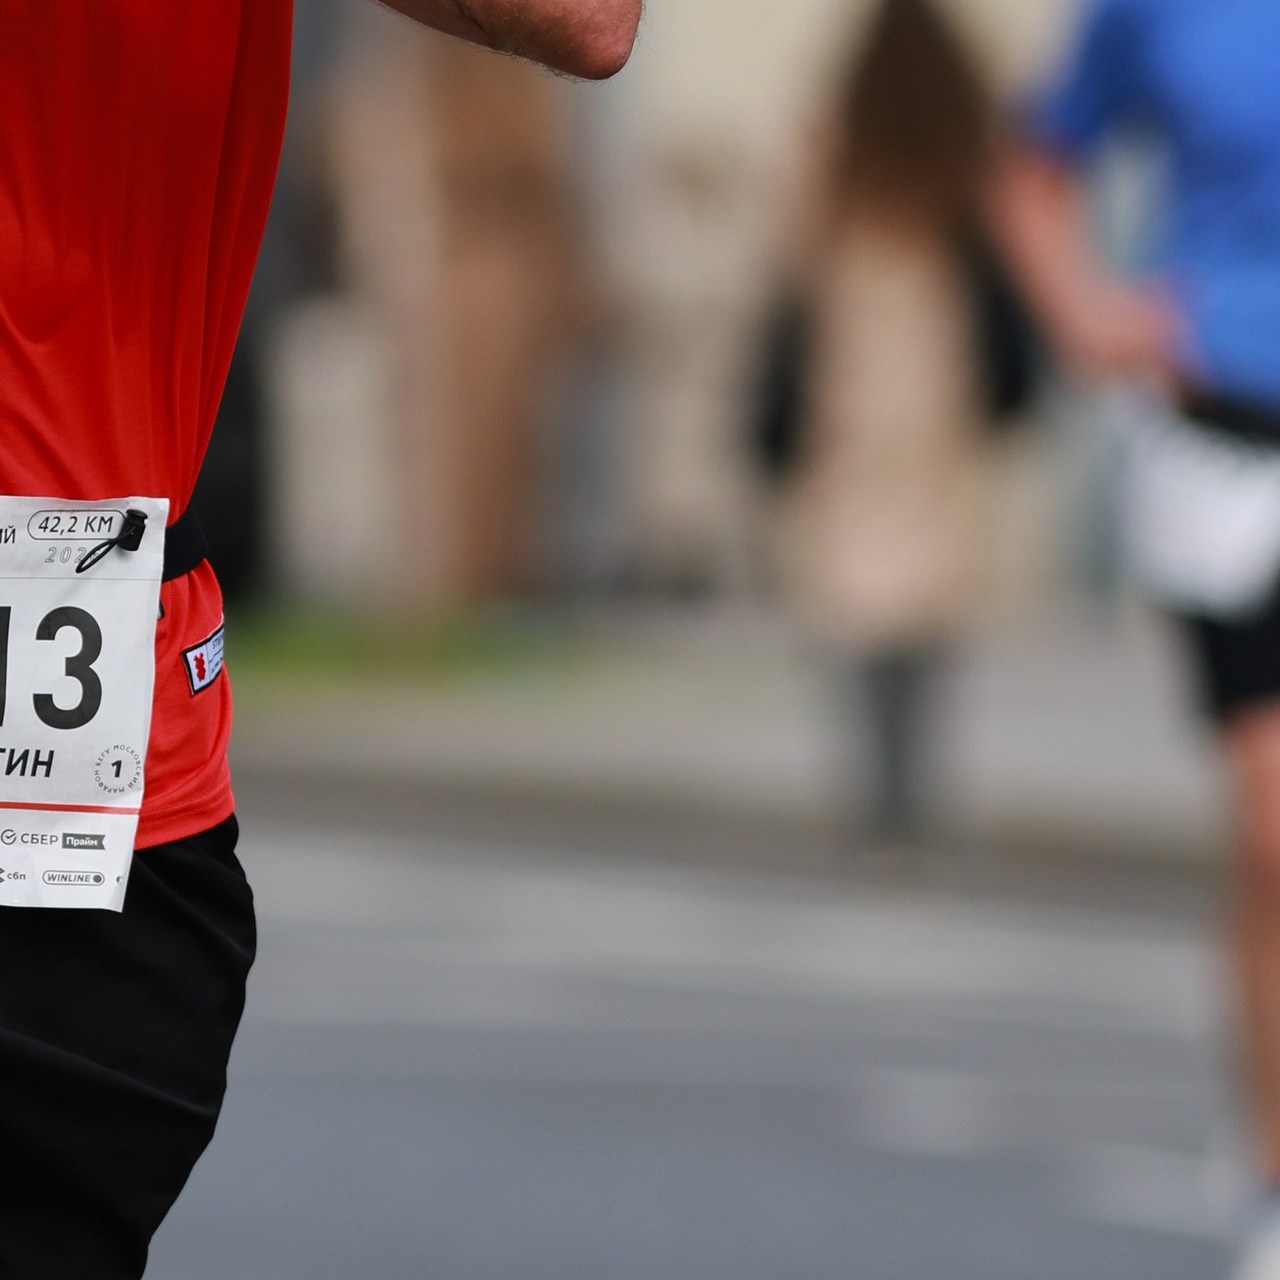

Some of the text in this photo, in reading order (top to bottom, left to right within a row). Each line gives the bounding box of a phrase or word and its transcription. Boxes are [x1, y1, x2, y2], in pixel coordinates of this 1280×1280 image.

[38, 516, 78, 536] 42,2
[111, 760, 122, 778] 1
[20, 832, 98, 847] СБЕР Прайм
[6, 871, 26, 880] сбп
[47, 873, 91, 883] WINLINE
